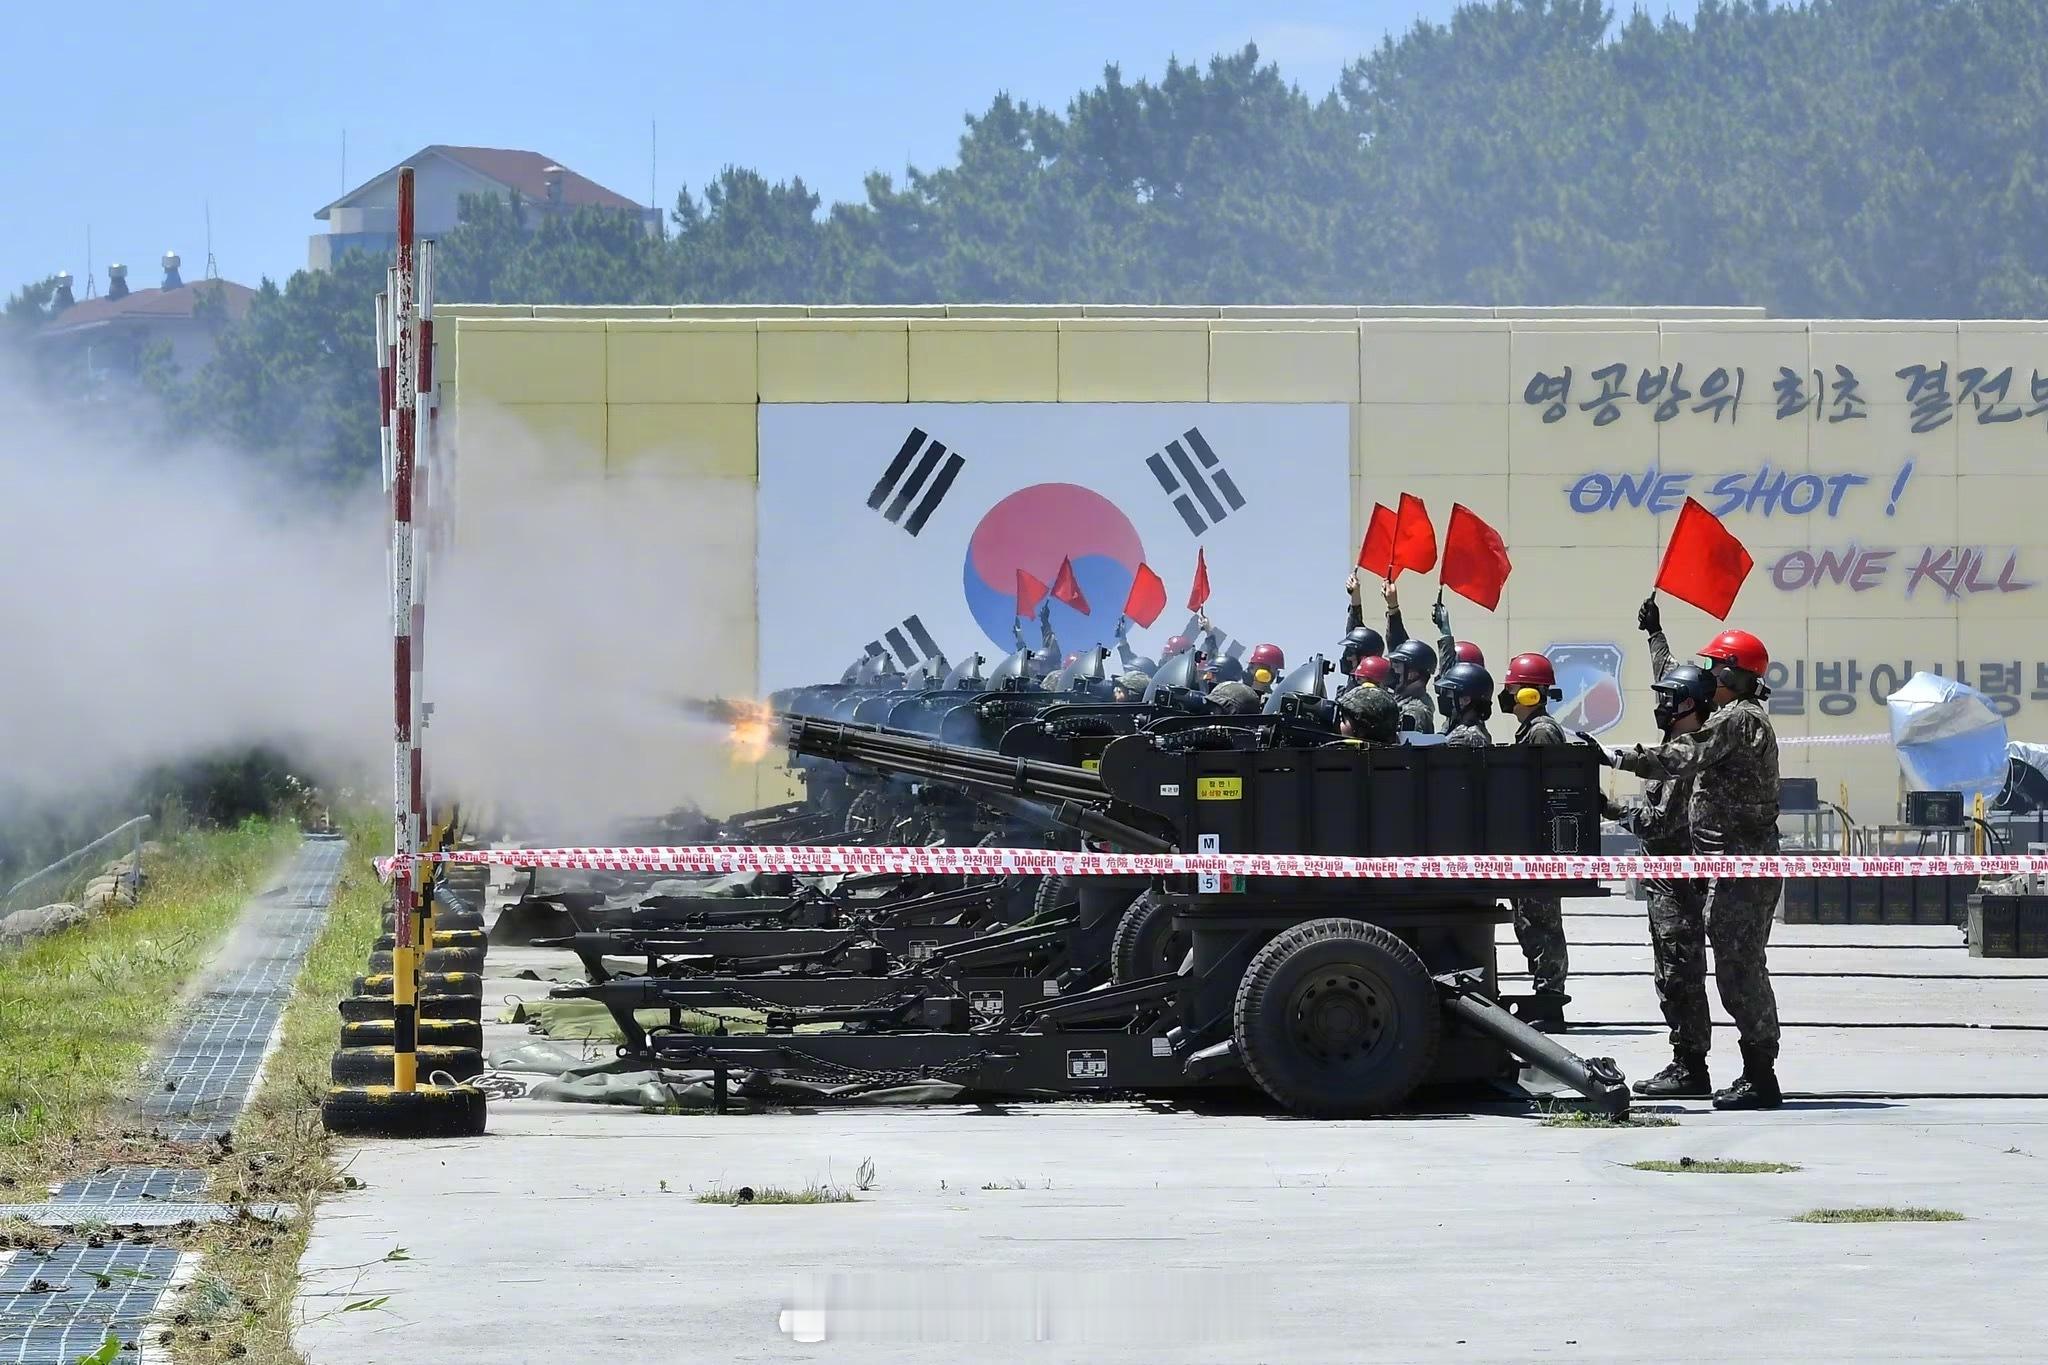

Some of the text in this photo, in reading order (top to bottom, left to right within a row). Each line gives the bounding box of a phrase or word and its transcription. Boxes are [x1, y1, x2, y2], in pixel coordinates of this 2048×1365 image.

[1523, 361, 1745, 427] 영공방위
[1772, 364, 1868, 423] 최초
[1566, 461, 1913, 517] ONE SHOT !
[1769, 545, 2039, 597] ONE KILL
[1203, 837, 1215, 849] M
[672, 852, 714, 864] DANGER!
[738, 852, 758, 865] 위험
[792, 852, 832, 865] 안전제일
[843, 854, 886, 865] DANGER!
[909, 855, 930, 866] 위험
[963, 854, 1003, 867] 안전제일
[1014, 855, 1056, 867] DANGER!
[1080, 856, 1100, 868] 위험
[1134, 857, 1173, 869] 안전제일
[1185, 857, 1227, 869] DANGER!
[1251, 858, 1271, 870] 위험
[1304, 858, 1344, 872] 안전제일
[1355, 861, 1398, 872] DANGER!
[1421, 862, 1441, 873] 위험
[1474, 861, 1514, 873] 안전제일
[1525, 861, 1567, 873] DANGER!
[1591, 862, 1610, 873] 위험
[1643, 861, 1682, 873] 안전제일
[1694, 862, 1736, 873] DANGER!
[1759, 862, 1779, 873] 위험
[1812, 861, 1850, 873] 안전제일
[1862, 861, 1904, 872] DANGER!
[1928, 861, 1948, 872] 위험
[1980, 860, 2019, 872] 안전제일
[1205, 878, 1213, 890] 5
